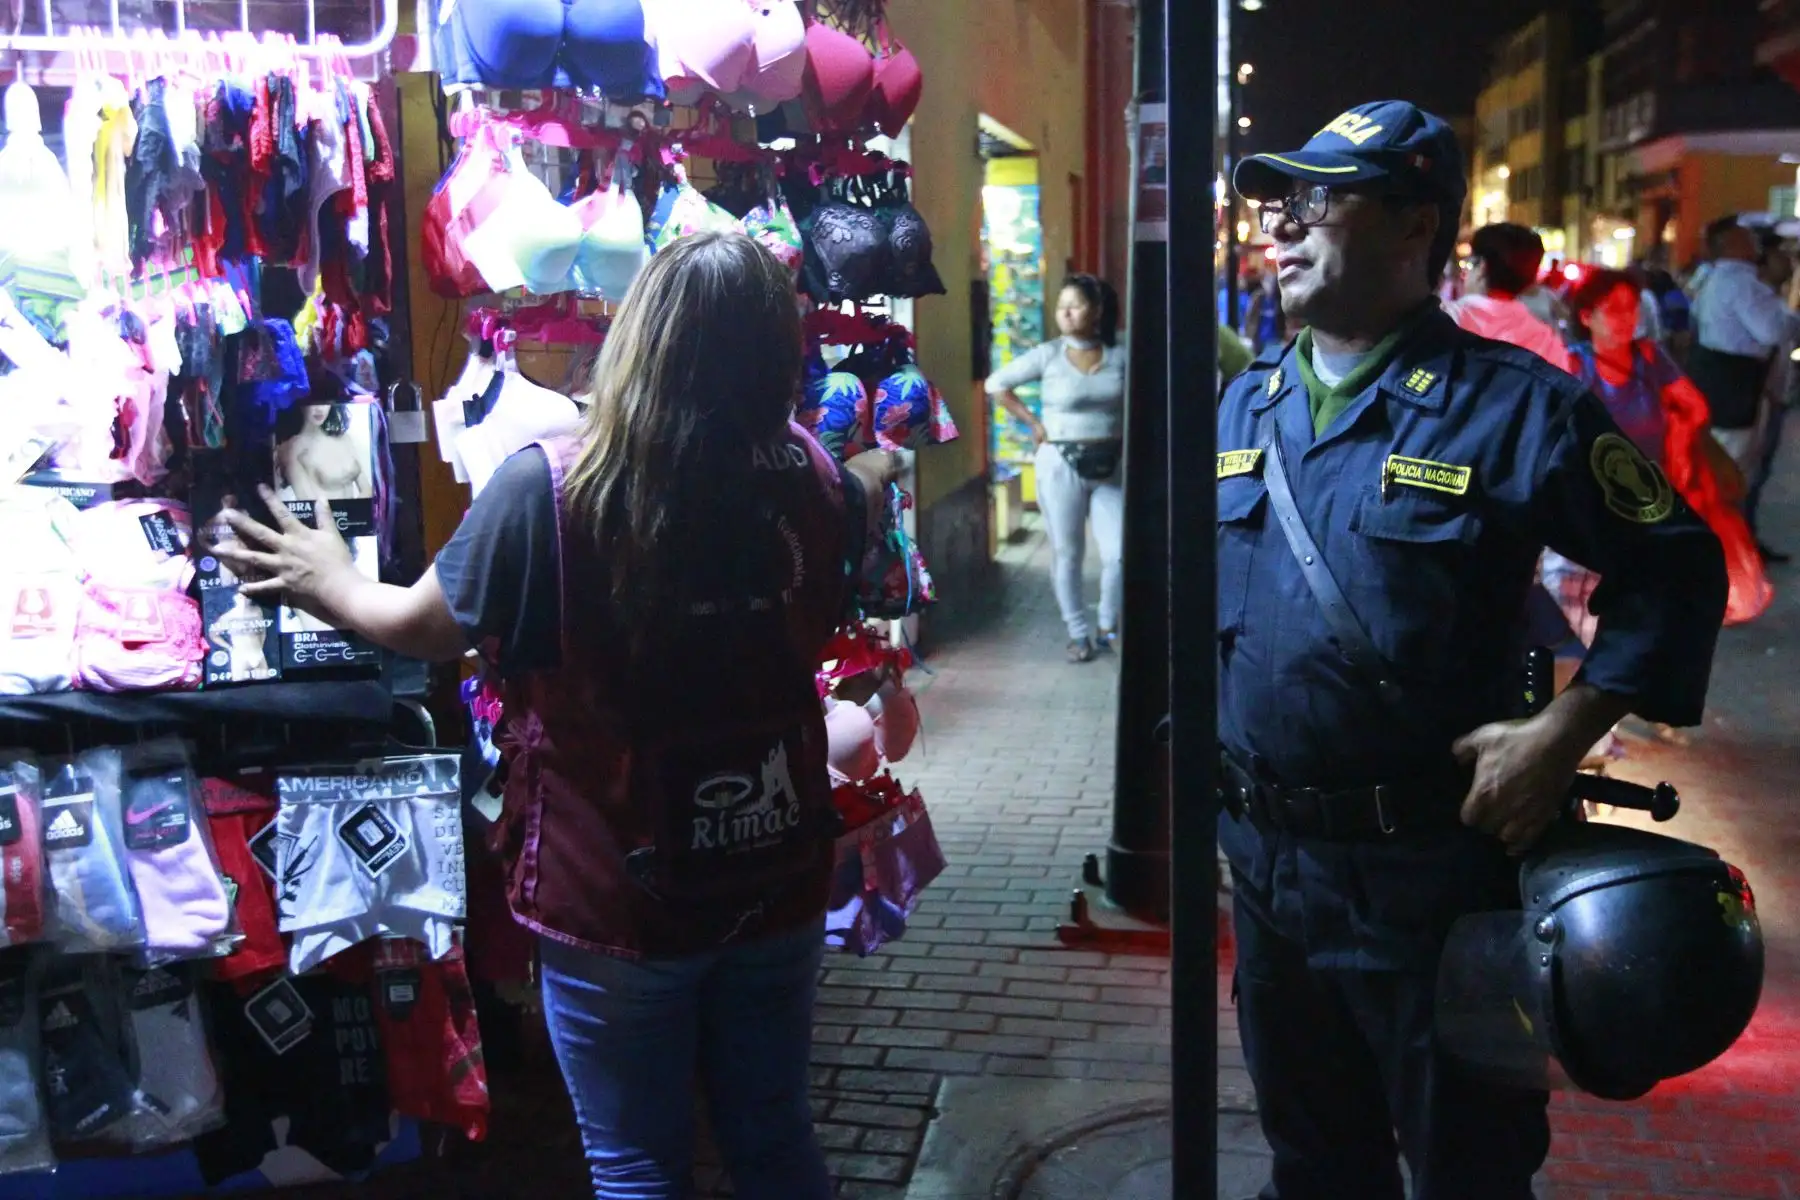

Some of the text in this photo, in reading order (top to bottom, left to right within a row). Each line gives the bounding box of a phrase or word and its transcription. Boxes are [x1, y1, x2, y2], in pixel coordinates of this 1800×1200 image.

[1390, 462, 1465, 487] POLICIA NACIONAL
[48, 487, 96, 497] MERICANO
[288, 502, 312, 512] BRA
[293, 633, 318, 642] BRA
[277, 771, 423, 793] AMERICANO
[46, 825, 85, 841] adidas
